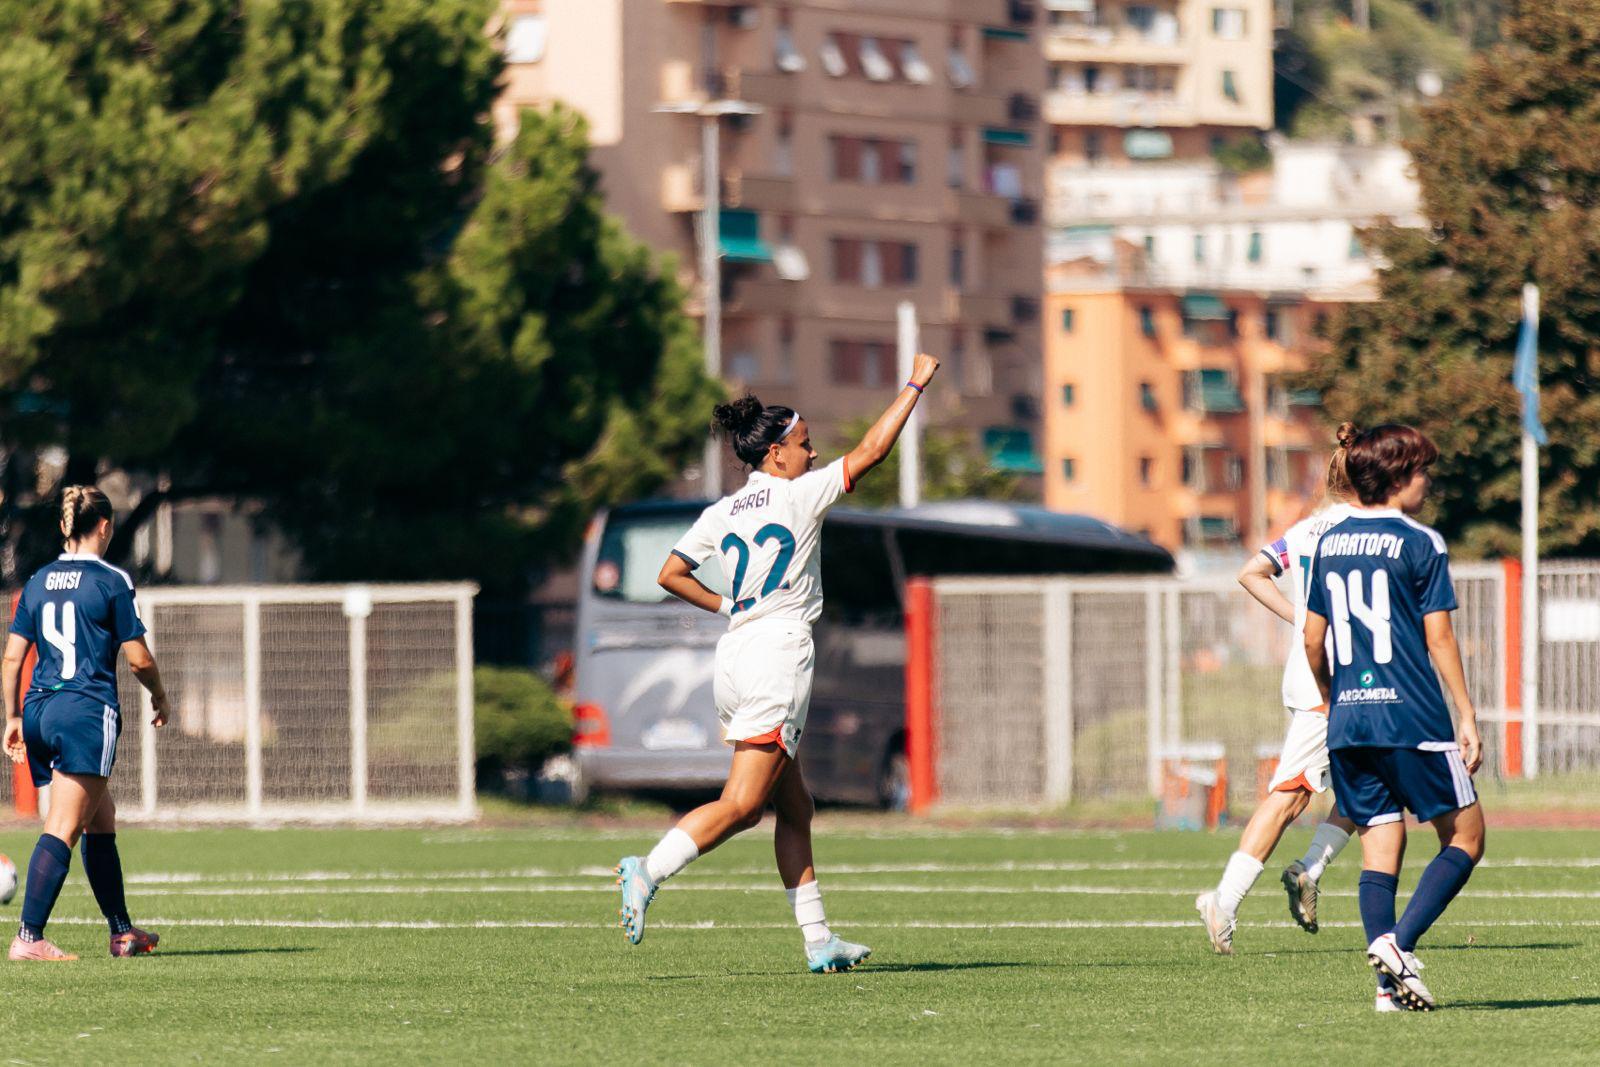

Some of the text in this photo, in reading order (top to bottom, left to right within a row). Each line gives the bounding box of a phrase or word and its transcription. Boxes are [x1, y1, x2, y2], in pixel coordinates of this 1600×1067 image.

[729, 488, 771, 516] BARGI
[45, 571, 82, 591] GHISI
[720, 523, 796, 616] 22
[42, 600, 76, 680] 4
[1325, 568, 1393, 666] 14
[1337, 687, 1398, 703] ARGOMETAL
